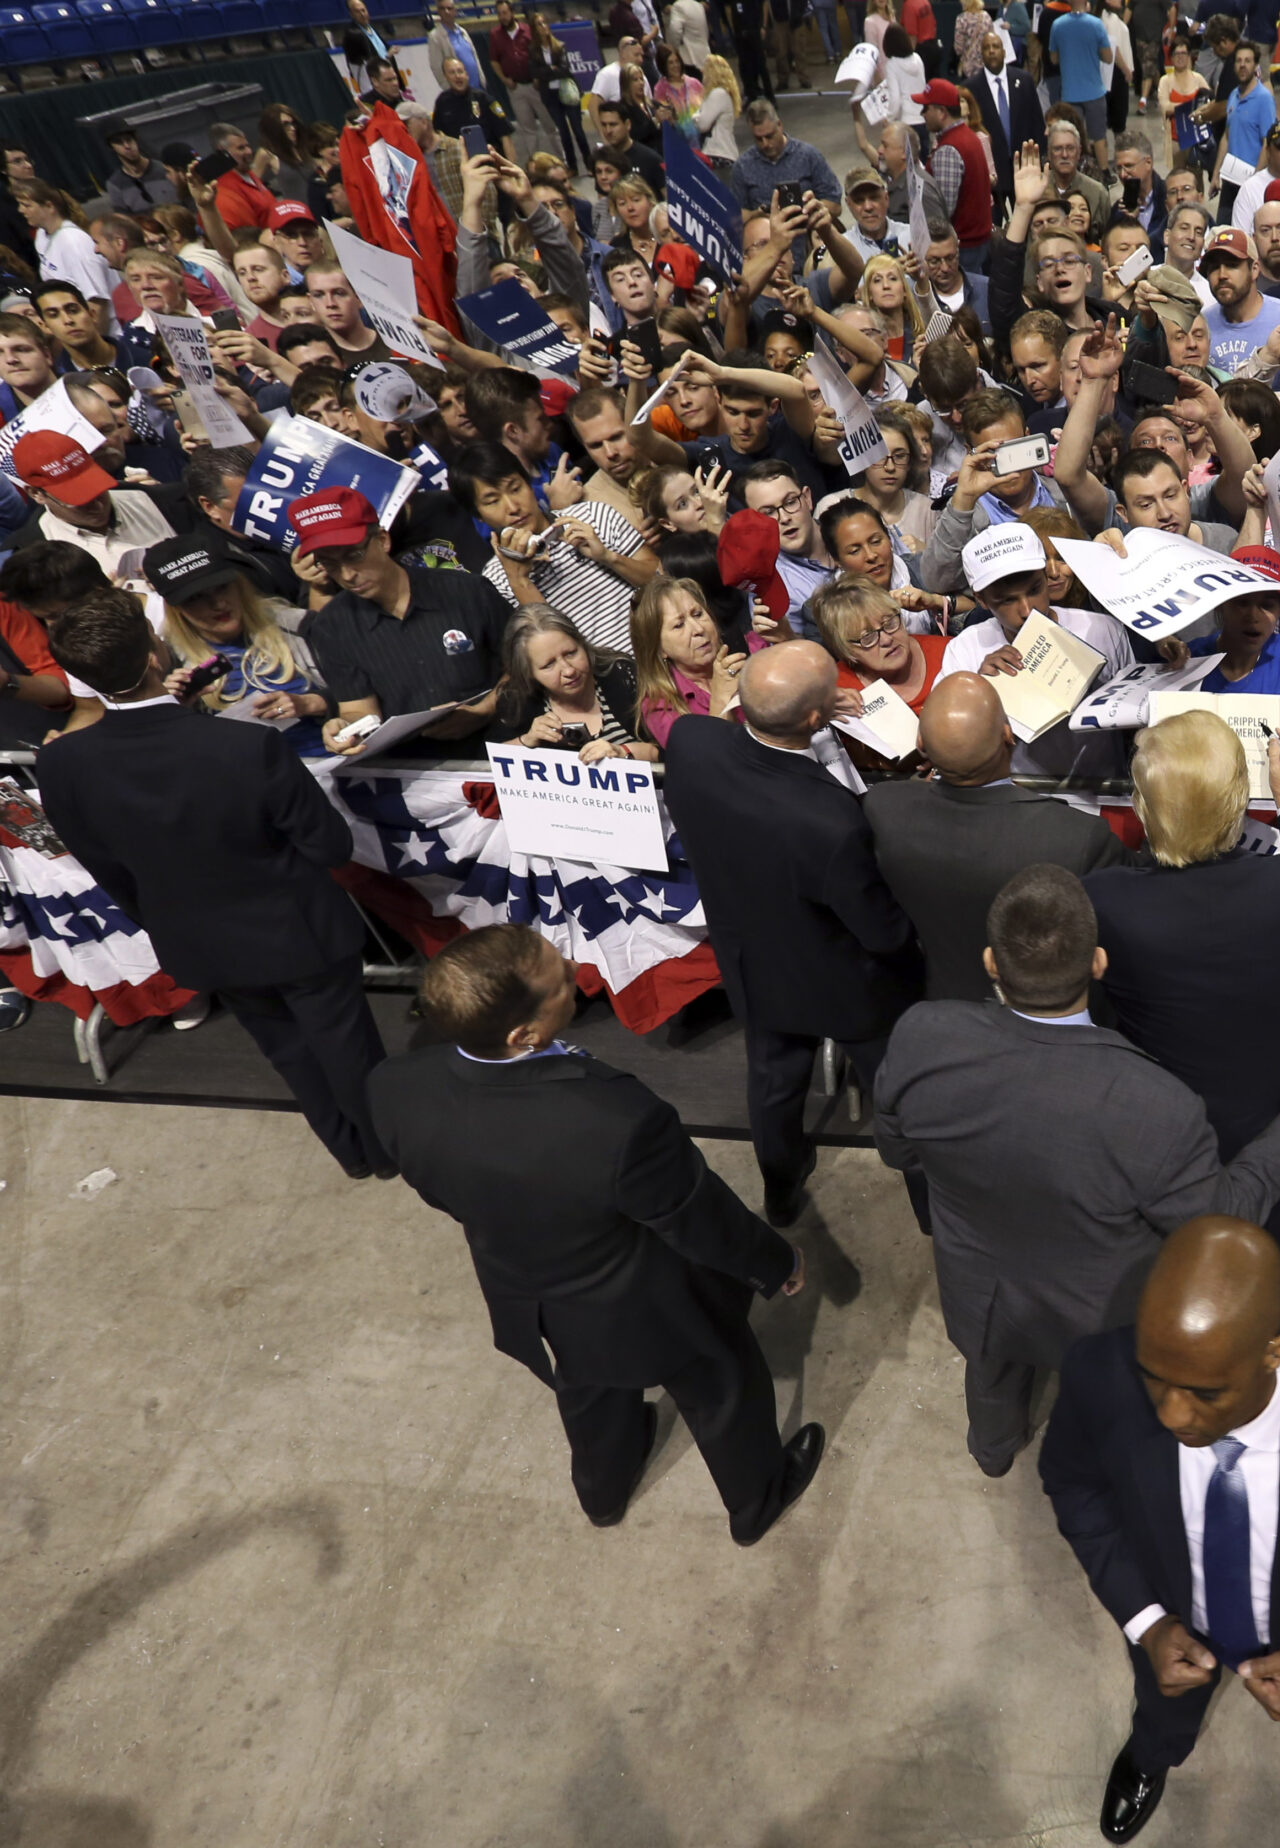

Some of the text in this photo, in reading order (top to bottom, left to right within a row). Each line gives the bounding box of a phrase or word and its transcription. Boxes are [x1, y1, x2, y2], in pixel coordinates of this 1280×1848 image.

[190, 346, 208, 360] FOR
[528, 340, 582, 367] TRUMP
[1215, 340, 1249, 358] BEACH
[841, 418, 883, 461] TRUMP
[244, 422, 314, 541] TRUMP
[294, 503, 343, 521] MAKE AMERICA
[300, 511, 343, 528] GREAT AGAIN
[974, 535, 1024, 557] MAKE AMERICA
[980, 543, 1024, 564] GREAT AGAIN
[158, 550, 209, 576] MAKE AMERICA
[167, 557, 211, 581] GREAT AGAIN
[1131, 567, 1279, 630] TRUMP
[1028, 642, 1053, 674] AMERICA
[862, 696, 886, 714] TRUMP
[1228, 716, 1268, 727] CRIPPLED
[493, 756, 650, 793] TRUMP
[500, 787, 655, 814] MAKE AMERICA GREAT AGAIN!
